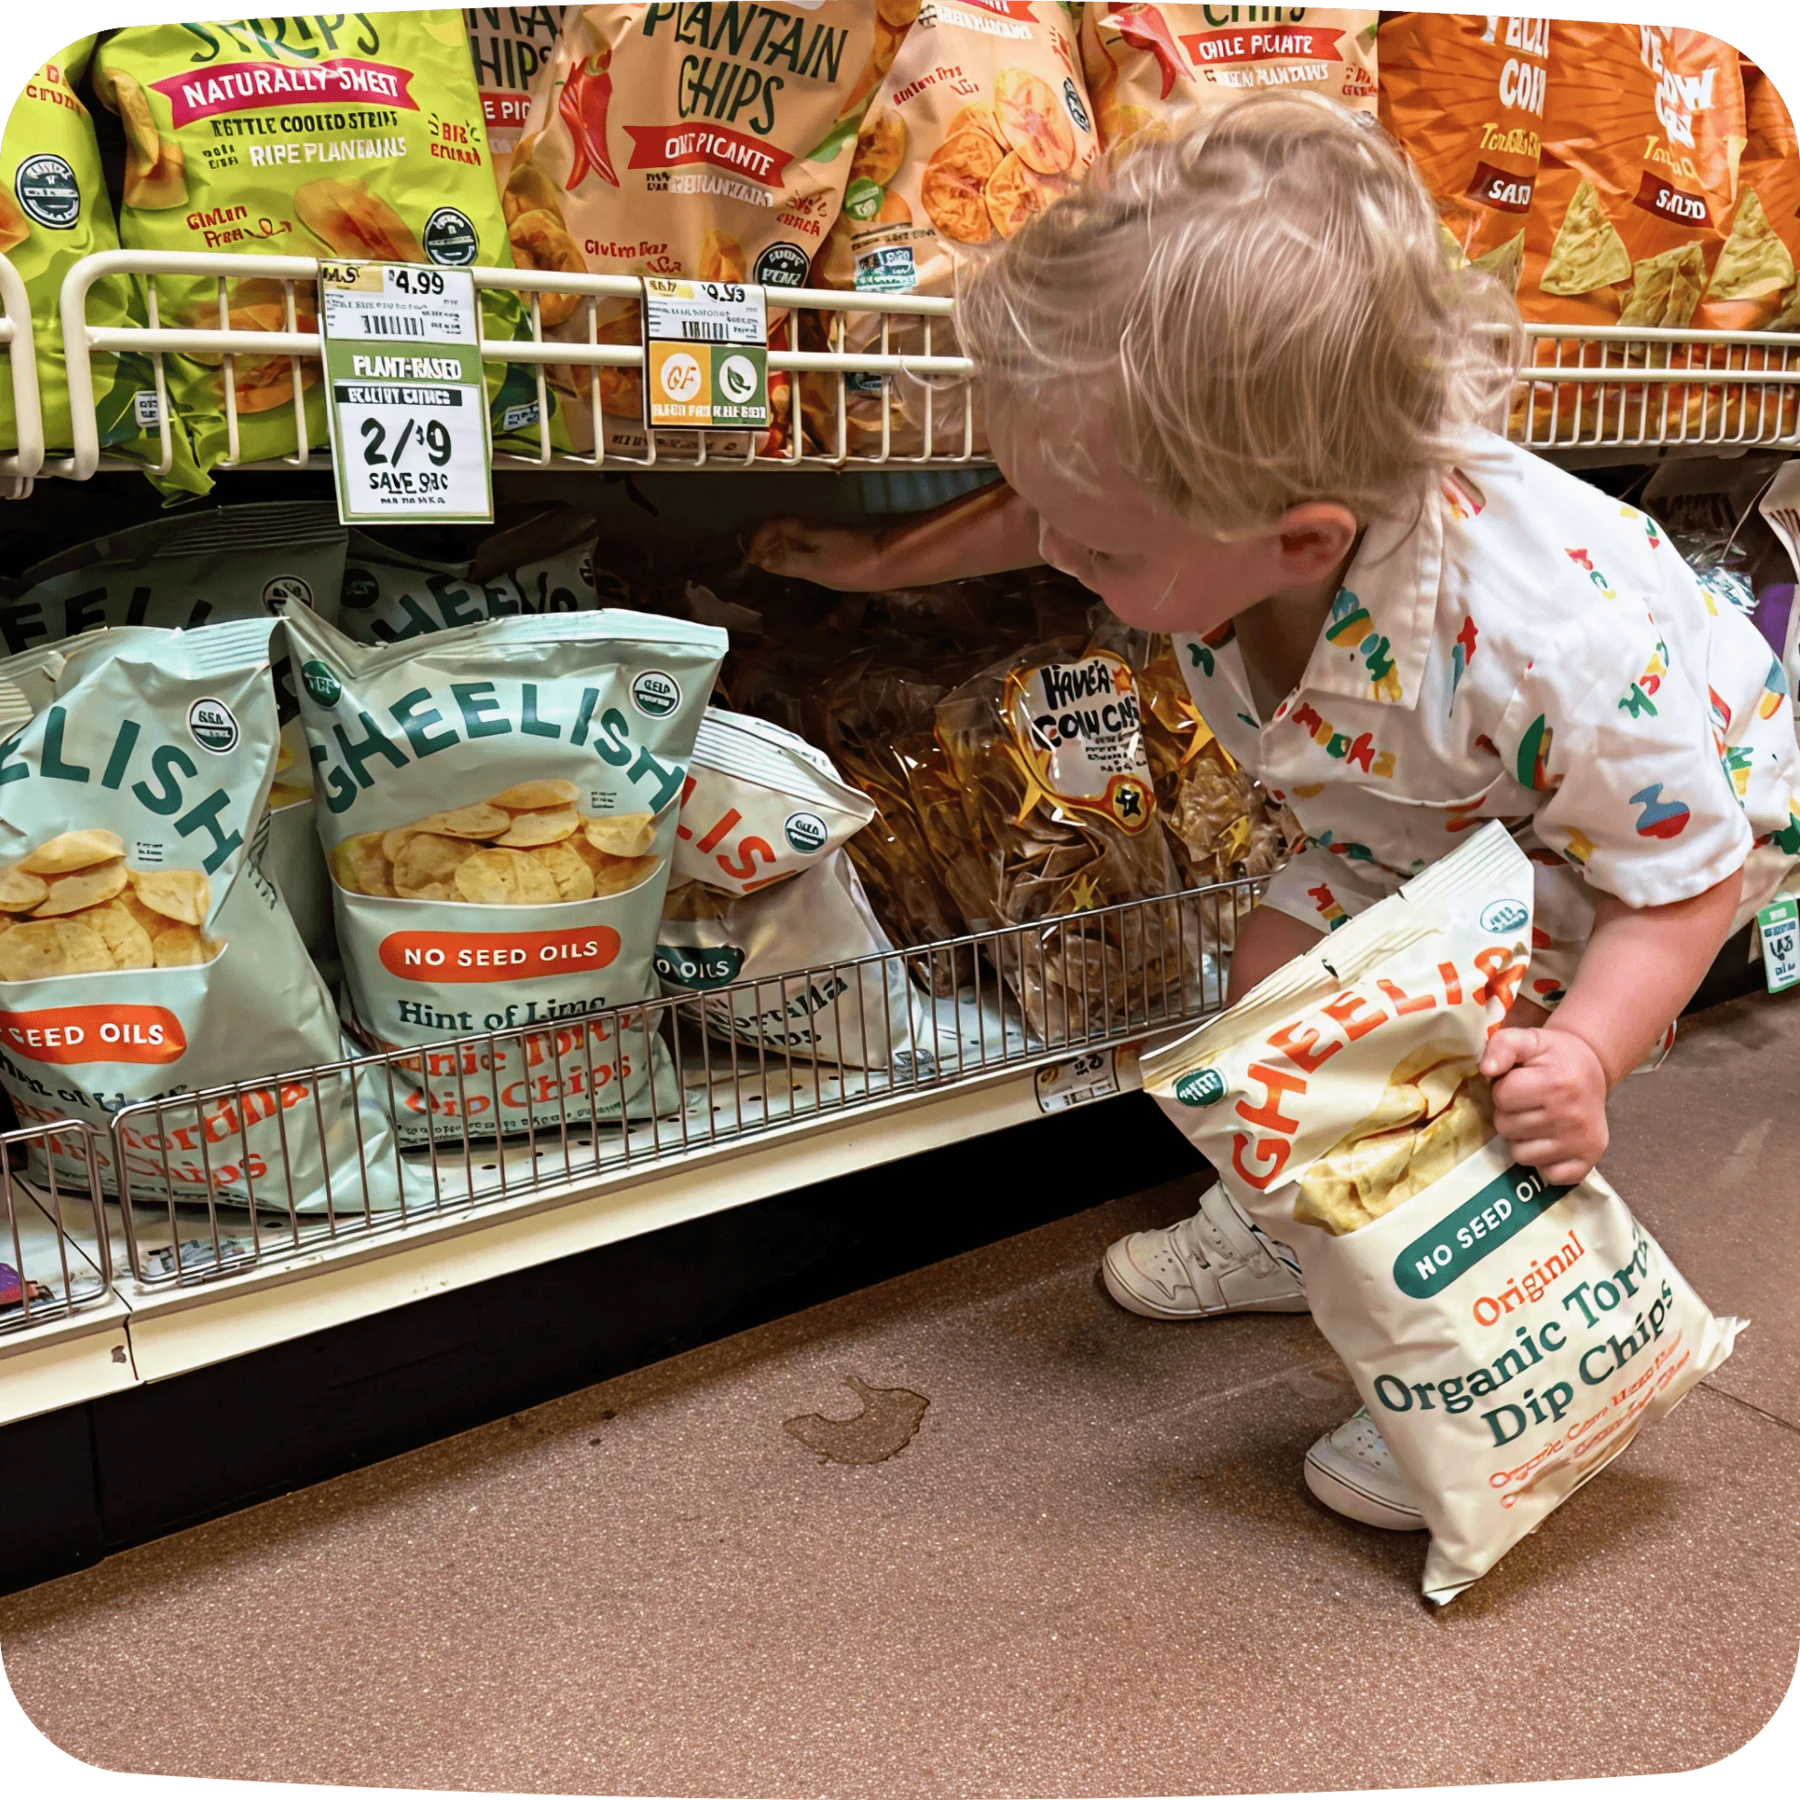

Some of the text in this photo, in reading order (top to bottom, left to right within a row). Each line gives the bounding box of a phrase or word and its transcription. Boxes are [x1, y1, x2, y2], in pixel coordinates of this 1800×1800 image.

[643, 2, 848, 82] PLANTAIN
[678, 55, 784, 135] CHIPS
[248, 143, 301, 167] RIPE
[310, 681, 686, 815] GHEELISH
[404, 940, 598, 967] NO SEED OILS
[99, 1022, 164, 1046] OILS
[398, 999, 474, 1031] Hint
[484, 1004, 519, 1030] of
[1415, 1173, 1548, 1281] NO SEED OI
[1373, 1322, 1567, 1414] Organic
[1480, 1381, 1574, 1448] Dip
[1578, 1278, 1673, 1386] Chips
